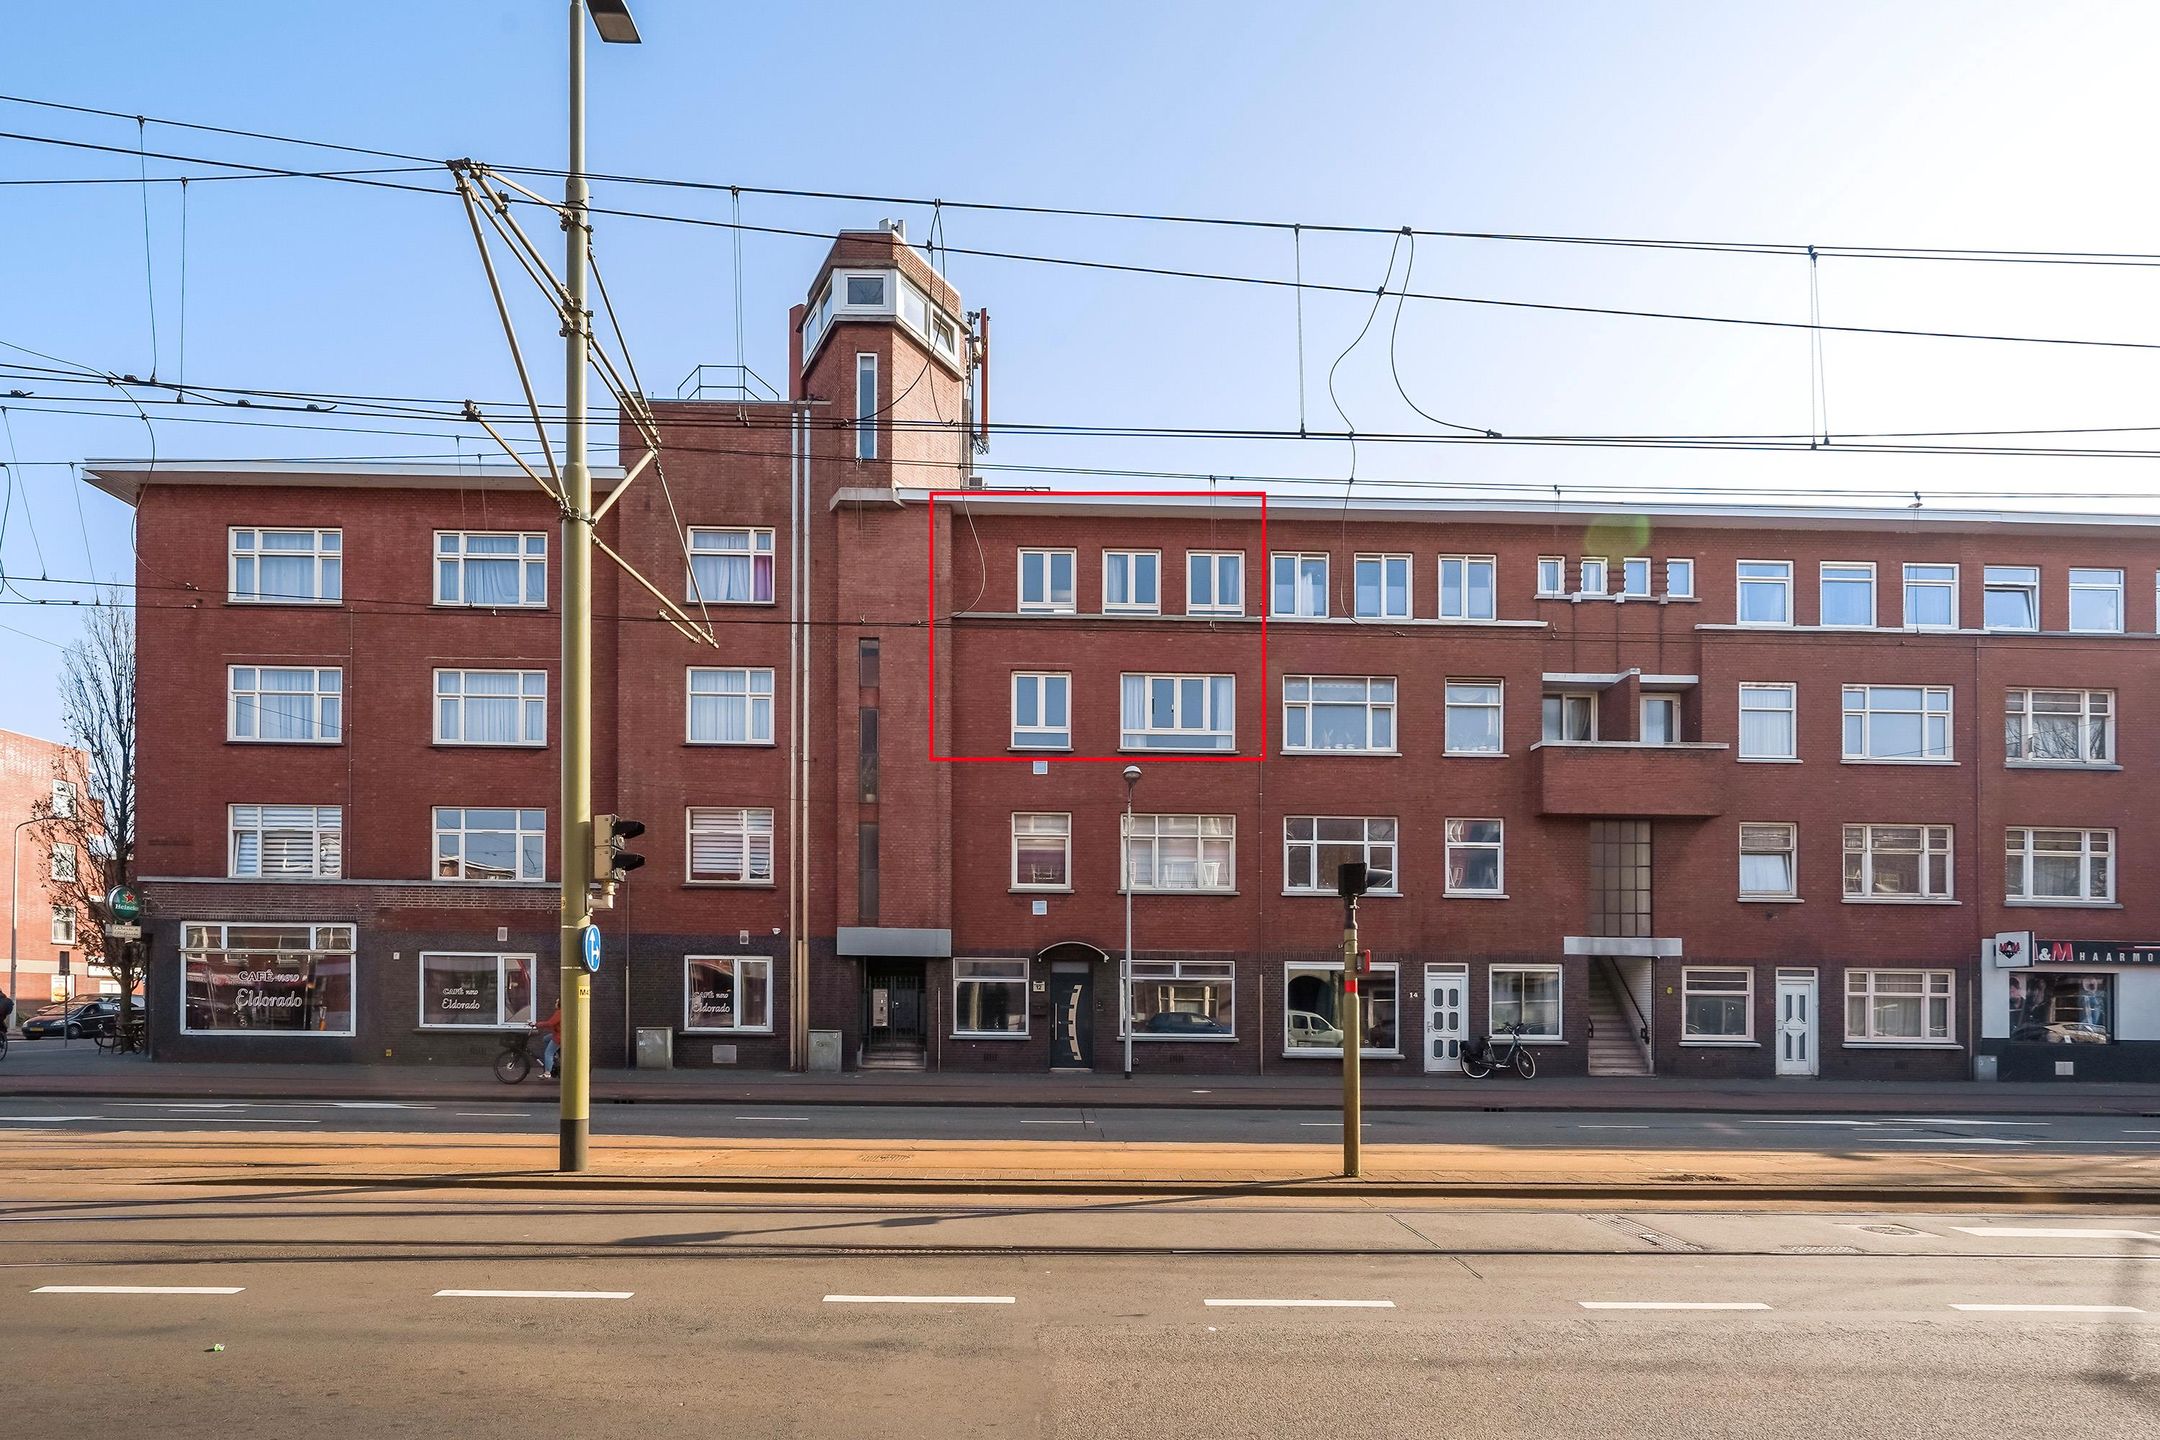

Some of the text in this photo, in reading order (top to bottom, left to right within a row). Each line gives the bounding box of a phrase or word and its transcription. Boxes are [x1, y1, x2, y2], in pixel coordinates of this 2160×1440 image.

[115, 903, 139, 911] Heinek
[238, 969, 274, 983] CAFÉ
[235, 988, 303, 1008] Eldorado
[441, 997, 480, 1010] Eldorado
